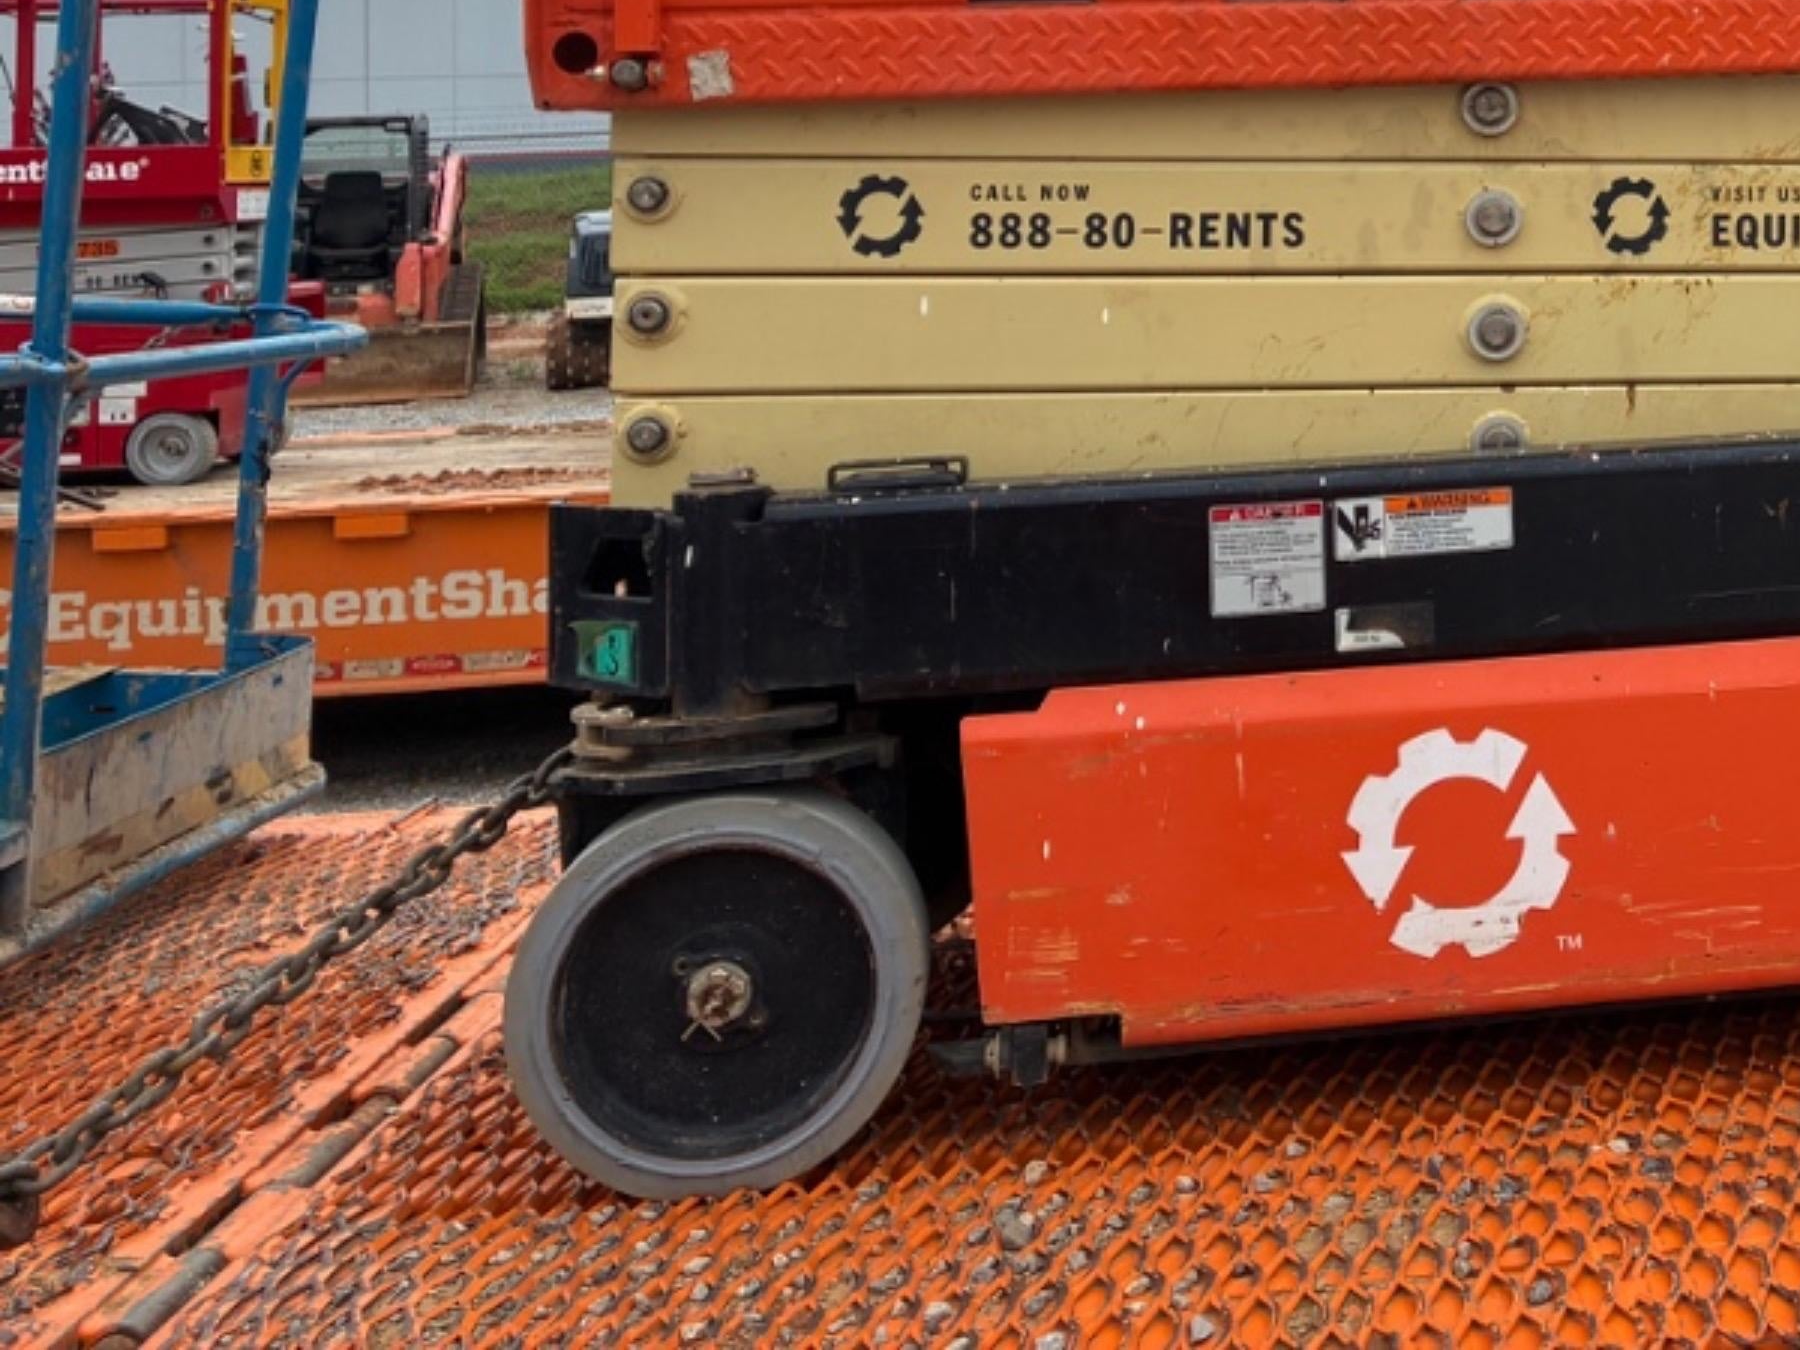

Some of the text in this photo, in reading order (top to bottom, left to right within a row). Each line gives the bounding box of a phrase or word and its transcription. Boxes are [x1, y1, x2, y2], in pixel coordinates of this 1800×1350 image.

[969, 184, 1091, 201] CALL NOW
[1709, 185, 1767, 203] VISIT
[969, 212, 1306, 250] 888-80-RENTS
[1555, 933, 1583, 951] TM
